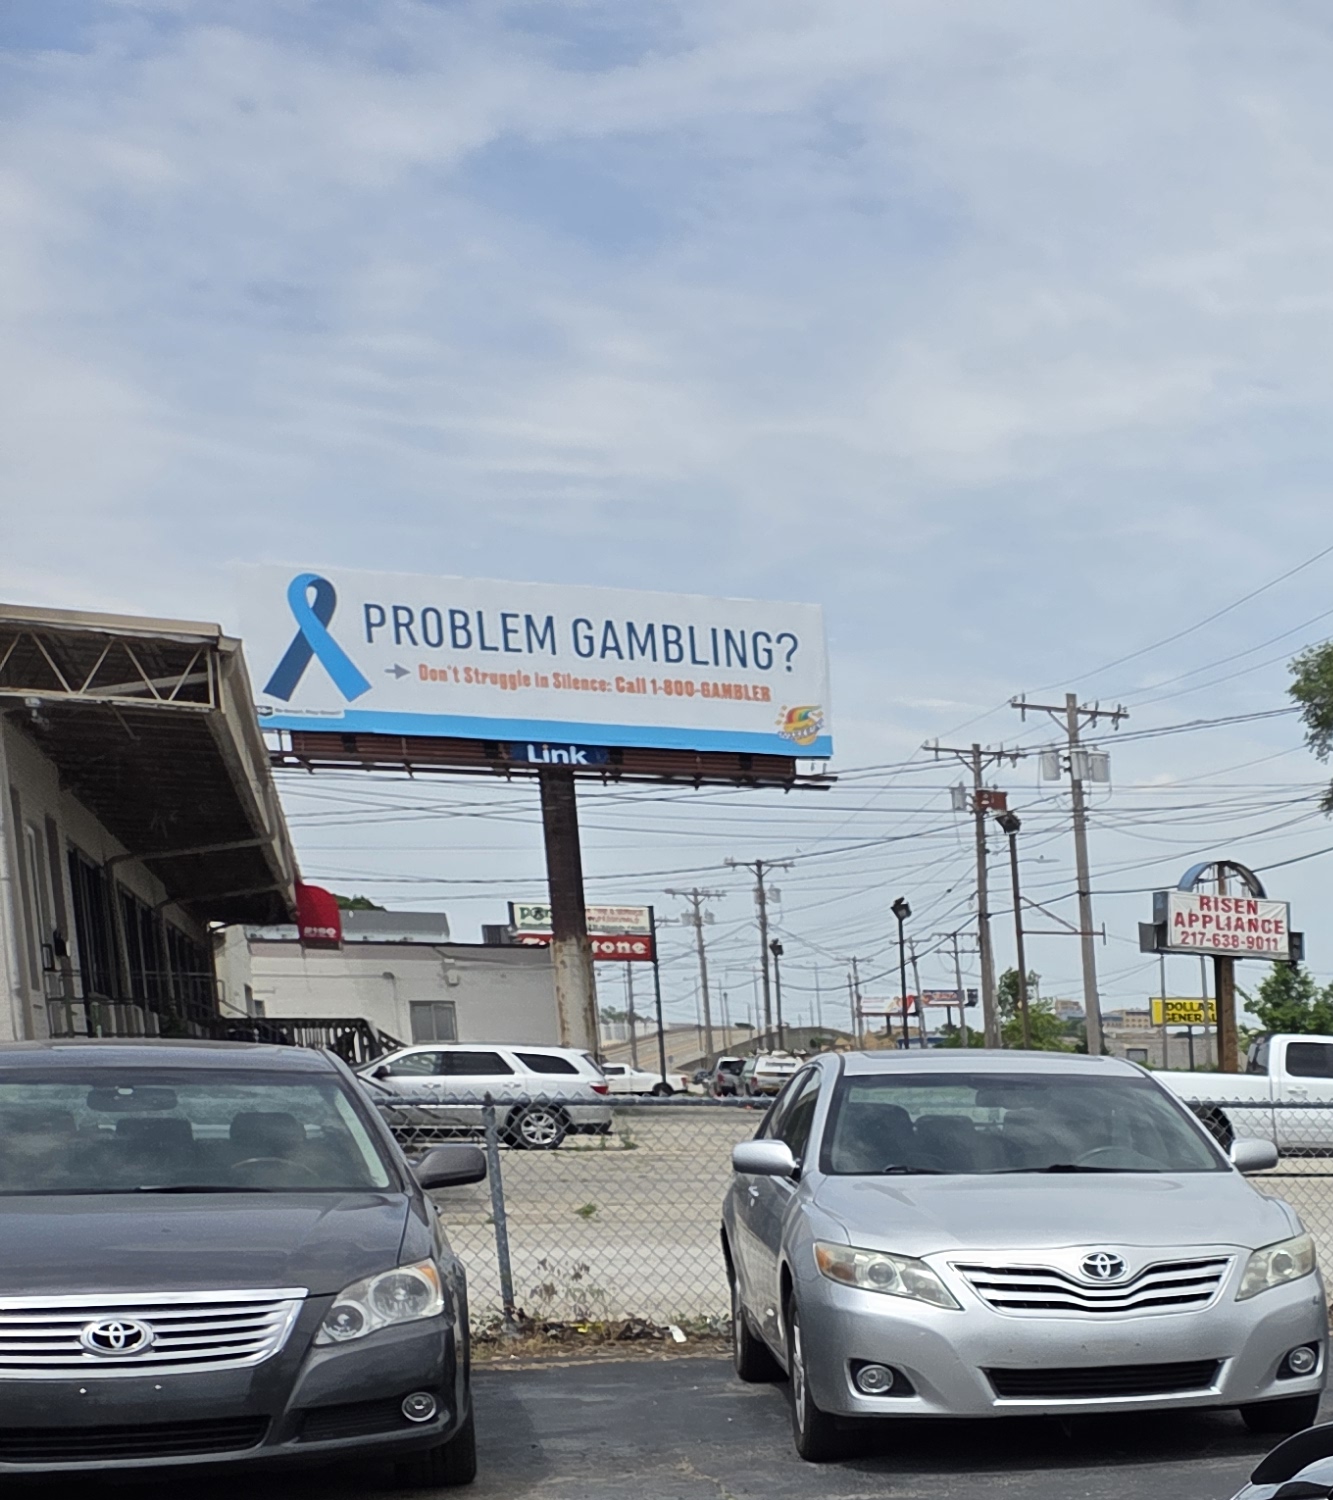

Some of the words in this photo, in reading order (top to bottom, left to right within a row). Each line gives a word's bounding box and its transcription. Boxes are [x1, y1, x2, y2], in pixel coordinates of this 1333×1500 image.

[364, 603, 557, 656] PROBLEM
[572, 618, 799, 673] GAMBLING?
[418, 662, 460, 683] Don't
[463, 667, 531, 691] Struggle
[552, 672, 613, 692] Silence:
[615, 676, 647, 695] Call
[650, 678, 772, 702] 1-800-GAMBLER
[527, 744, 590, 765] Link
[1200, 896, 1258, 915] RISEN
[1174, 912, 1285, 935] APPLIANCE
[1181, 931, 1279, 951] 217-638-9011
[1165, 1002, 1215, 1013] DOLLAR
[1166, 1012, 1217, 1023] GENERL
